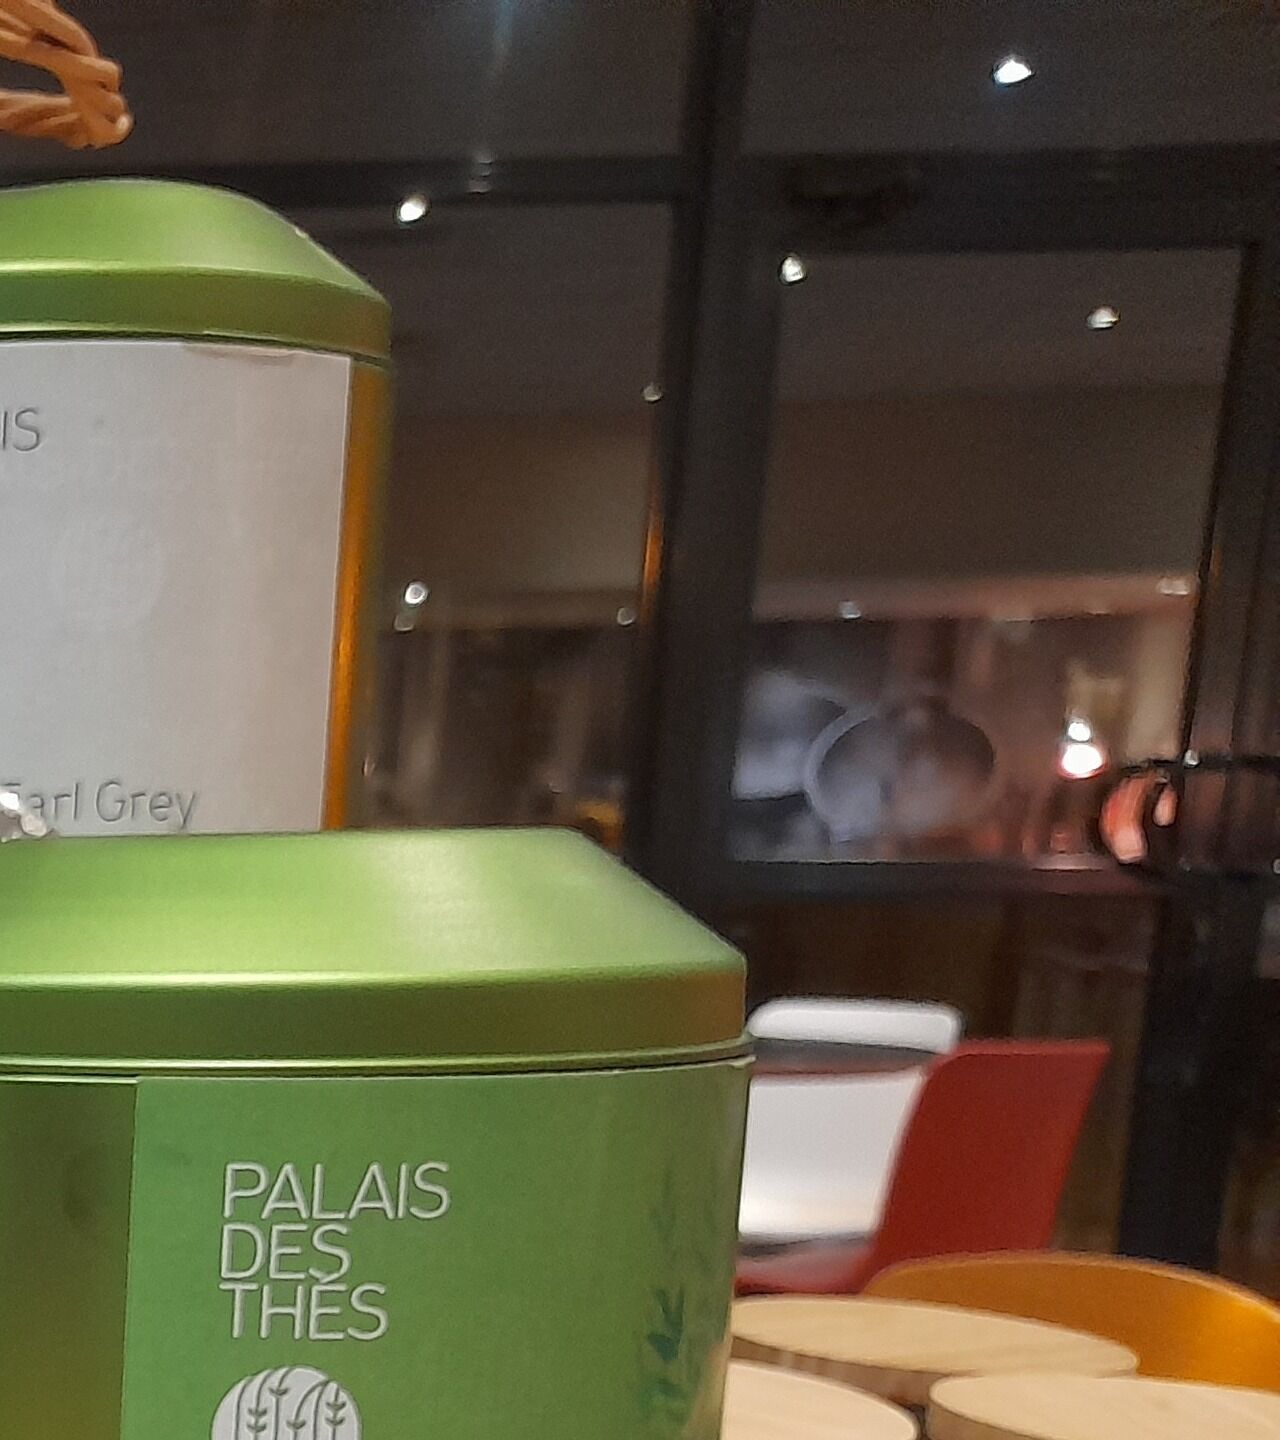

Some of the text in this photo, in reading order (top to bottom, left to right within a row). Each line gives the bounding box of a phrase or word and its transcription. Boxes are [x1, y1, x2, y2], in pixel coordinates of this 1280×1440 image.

[95, 779, 197, 830] Grey
[222, 1160, 452, 1220] PALAIS
[220, 1222, 352, 1280] DES
[219, 1275, 389, 1340] THÉS
